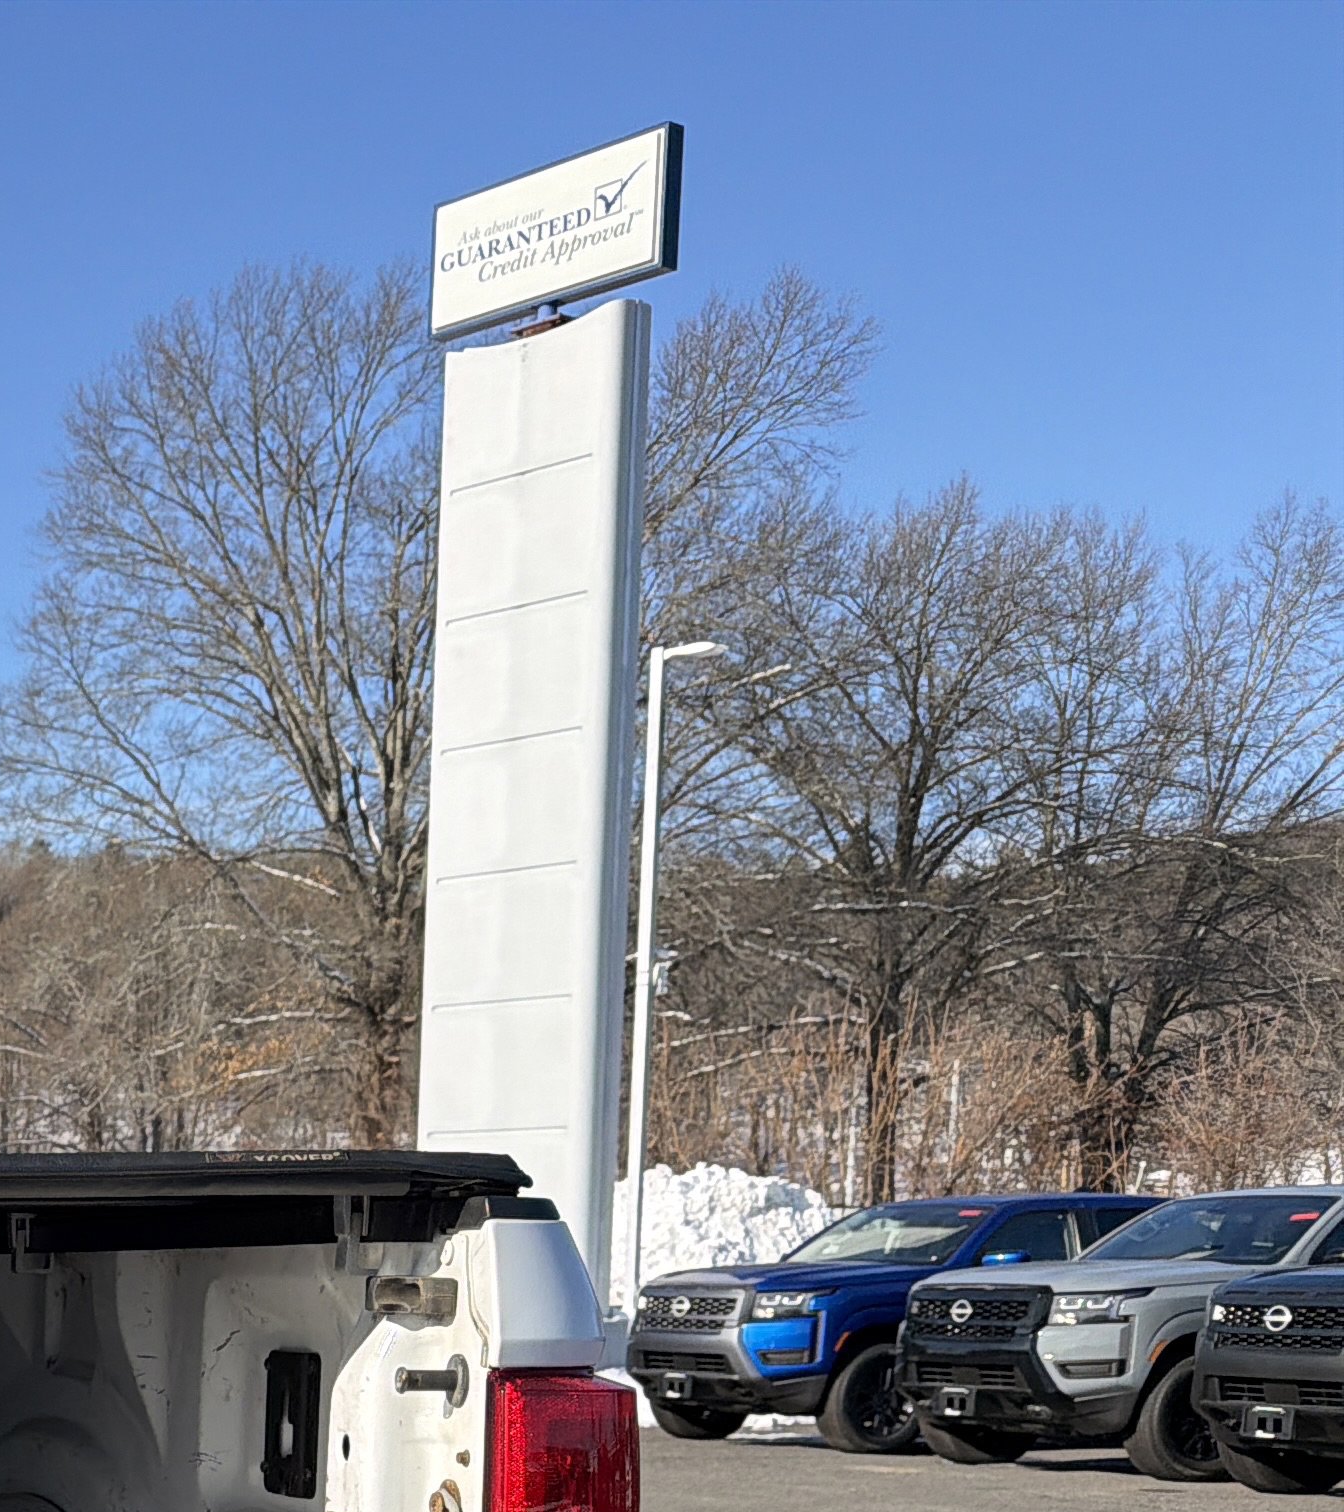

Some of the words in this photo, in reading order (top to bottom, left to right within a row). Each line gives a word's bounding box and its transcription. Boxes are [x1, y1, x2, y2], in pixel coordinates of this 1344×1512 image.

[440, 207, 592, 273] GUARANTEED
[457, 228, 480, 247] Ask
[483, 215, 518, 238] about
[521, 207, 545, 226] our
[478, 247, 537, 283] Credit
[540, 212, 635, 267] Approval
